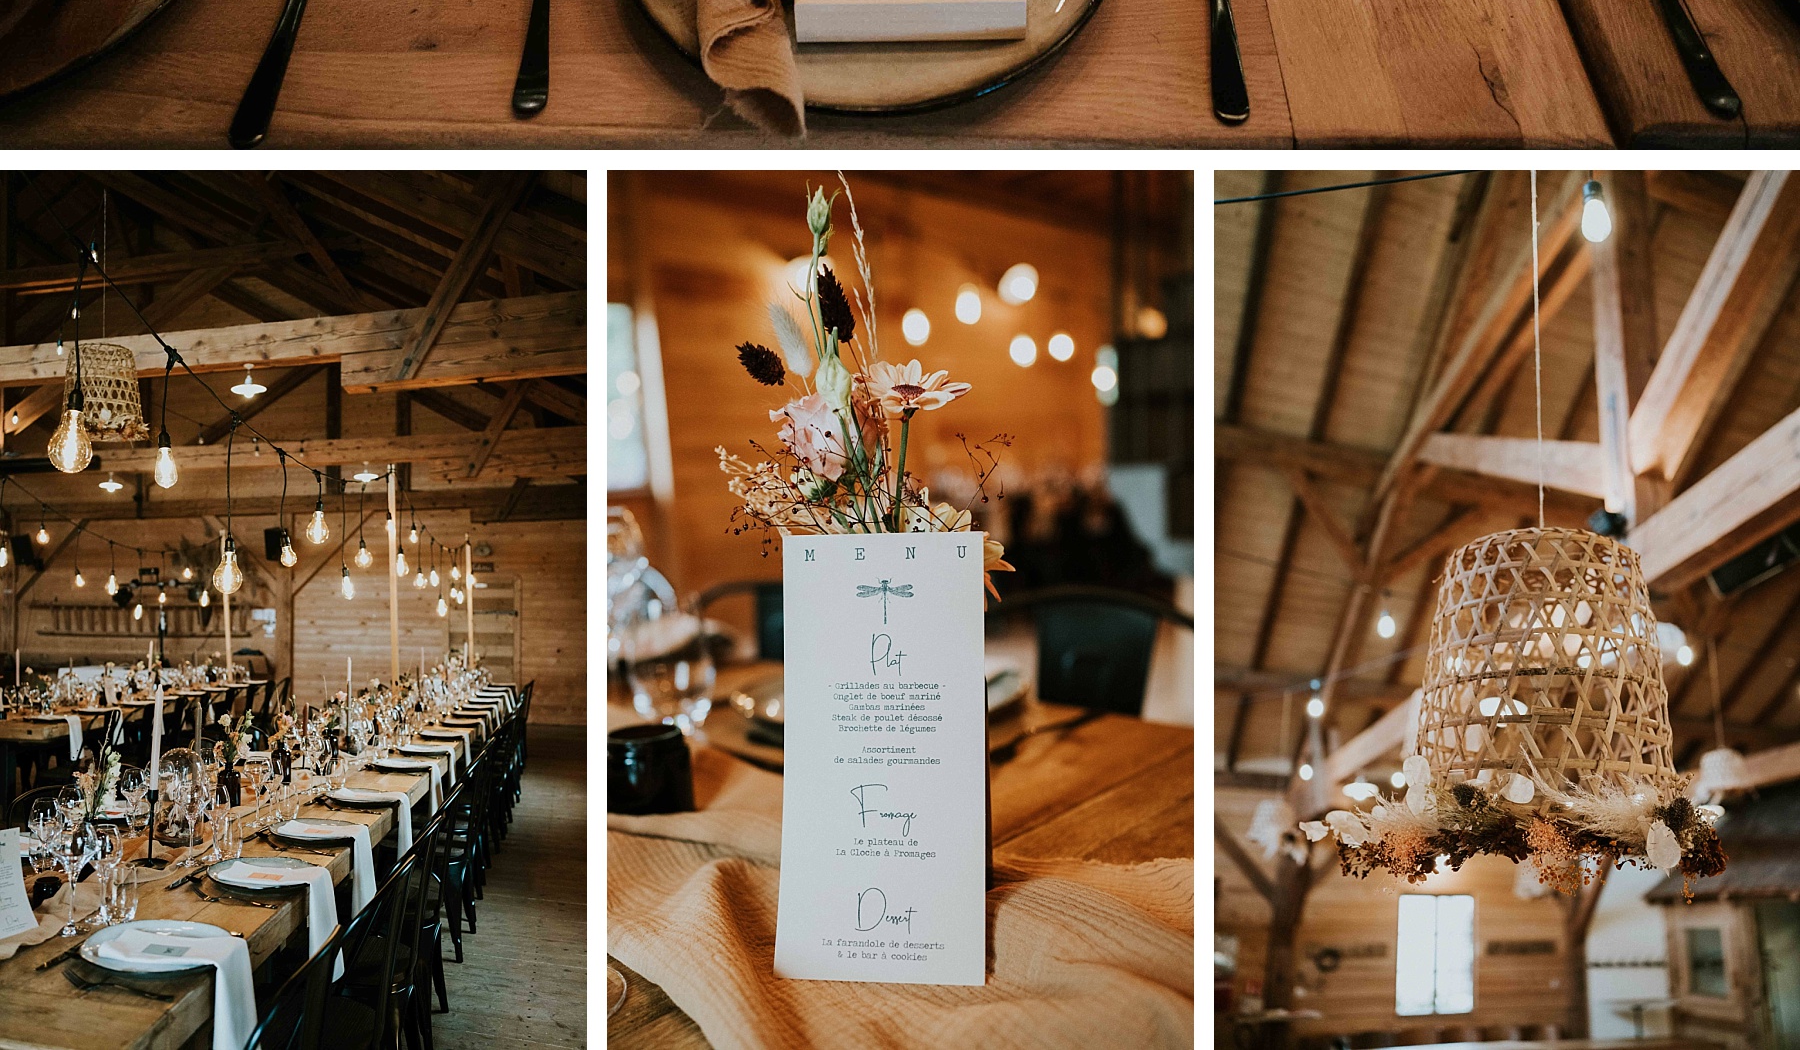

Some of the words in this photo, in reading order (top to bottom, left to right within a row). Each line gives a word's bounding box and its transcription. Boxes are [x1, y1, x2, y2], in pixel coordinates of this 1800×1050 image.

[869, 633, 908, 676] Plat
[834, 681, 880, 691] Grillades
[883, 682, 895, 690] au
[898, 681, 939, 690] barbecue
[833, 692, 864, 702] Onglet
[866, 692, 877, 701] de
[880, 692, 906, 701] boeuf
[908, 691, 941, 701] mariné
[848, 703, 881, 711] Gambas
[883, 702, 926, 711] marinées
[831, 714, 857, 722] Steak
[860, 714, 871, 722] de
[874, 714, 905, 724] poulet
[907, 713, 943, 722] désossé
[838, 724, 883, 733] Brochette
[885, 724, 896, 733] de
[899, 724, 937, 734] légumes
[861, 745, 916, 754] Assortiment
[833, 756, 844, 764] de
[847, 756, 884, 765] salades
[887, 757, 941, 767] gourmandes
[850, 783, 917, 837] Fromage
[853, 838, 864, 846] Le
[867, 838, 904, 848] plateau
[907, 838, 919, 846] de
[836, 848, 846, 856] La
[850, 848, 881, 857] Cloche
[883, 848, 890, 857] à
[893, 849, 937, 860] Fromages
[854, 887, 918, 934] Dessert
[822, 938, 833, 946] La
[836, 939, 885, 948] farandole
[888, 940, 900, 948] de
[903, 940, 945, 950] desserts
[837, 950, 844, 958] &
[847, 950, 858, 959] le
[861, 951, 878, 960] bar
[881, 951, 887, 960] à
[890, 952, 928, 961] cookies
